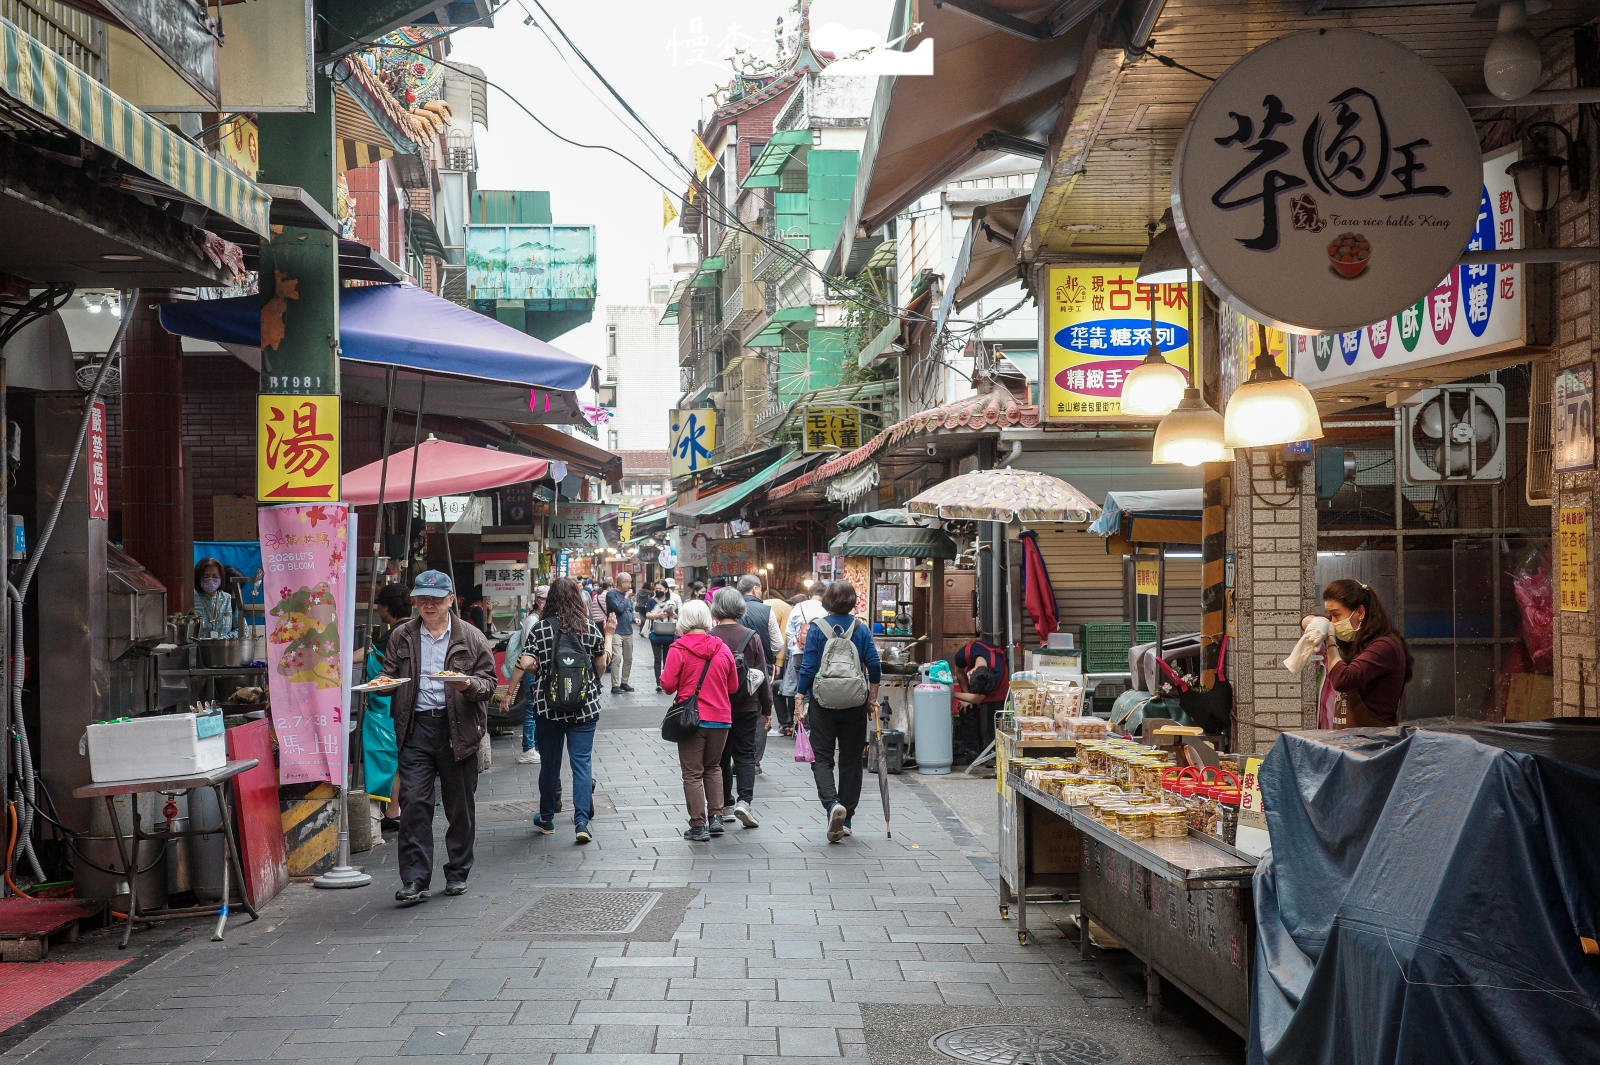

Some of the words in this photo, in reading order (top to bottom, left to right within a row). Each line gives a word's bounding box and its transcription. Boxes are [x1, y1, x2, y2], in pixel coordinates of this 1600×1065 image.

[1211, 87, 1451, 252] 芋圓王
[1330, 214, 1361, 227] Taro
[1363, 217, 1384, 227] rice
[1386, 214, 1416, 227] balls
[1418, 214, 1451, 230] King
[1092, 276, 1105, 311] 現做
[1107, 275, 1188, 311] 古早味
[1110, 327, 1174, 347] 糖系列
[269, 376, 321, 388] B7981
[266, 402, 334, 477] 湯
[672, 413, 712, 472] 冰
[808, 409, 827, 449] 毛筆
[839, 408, 858, 450] 古董
[91, 407, 105, 513] 嚴禁煙火
[551, 523, 598, 539] 仙草茶
[268, 552, 294, 563] 2026
[295, 551, 314, 560] LET'S
[268, 563, 285, 572] GO
[287, 561, 315, 571] BLOOM
[485, 568, 524, 581] 青草茶
